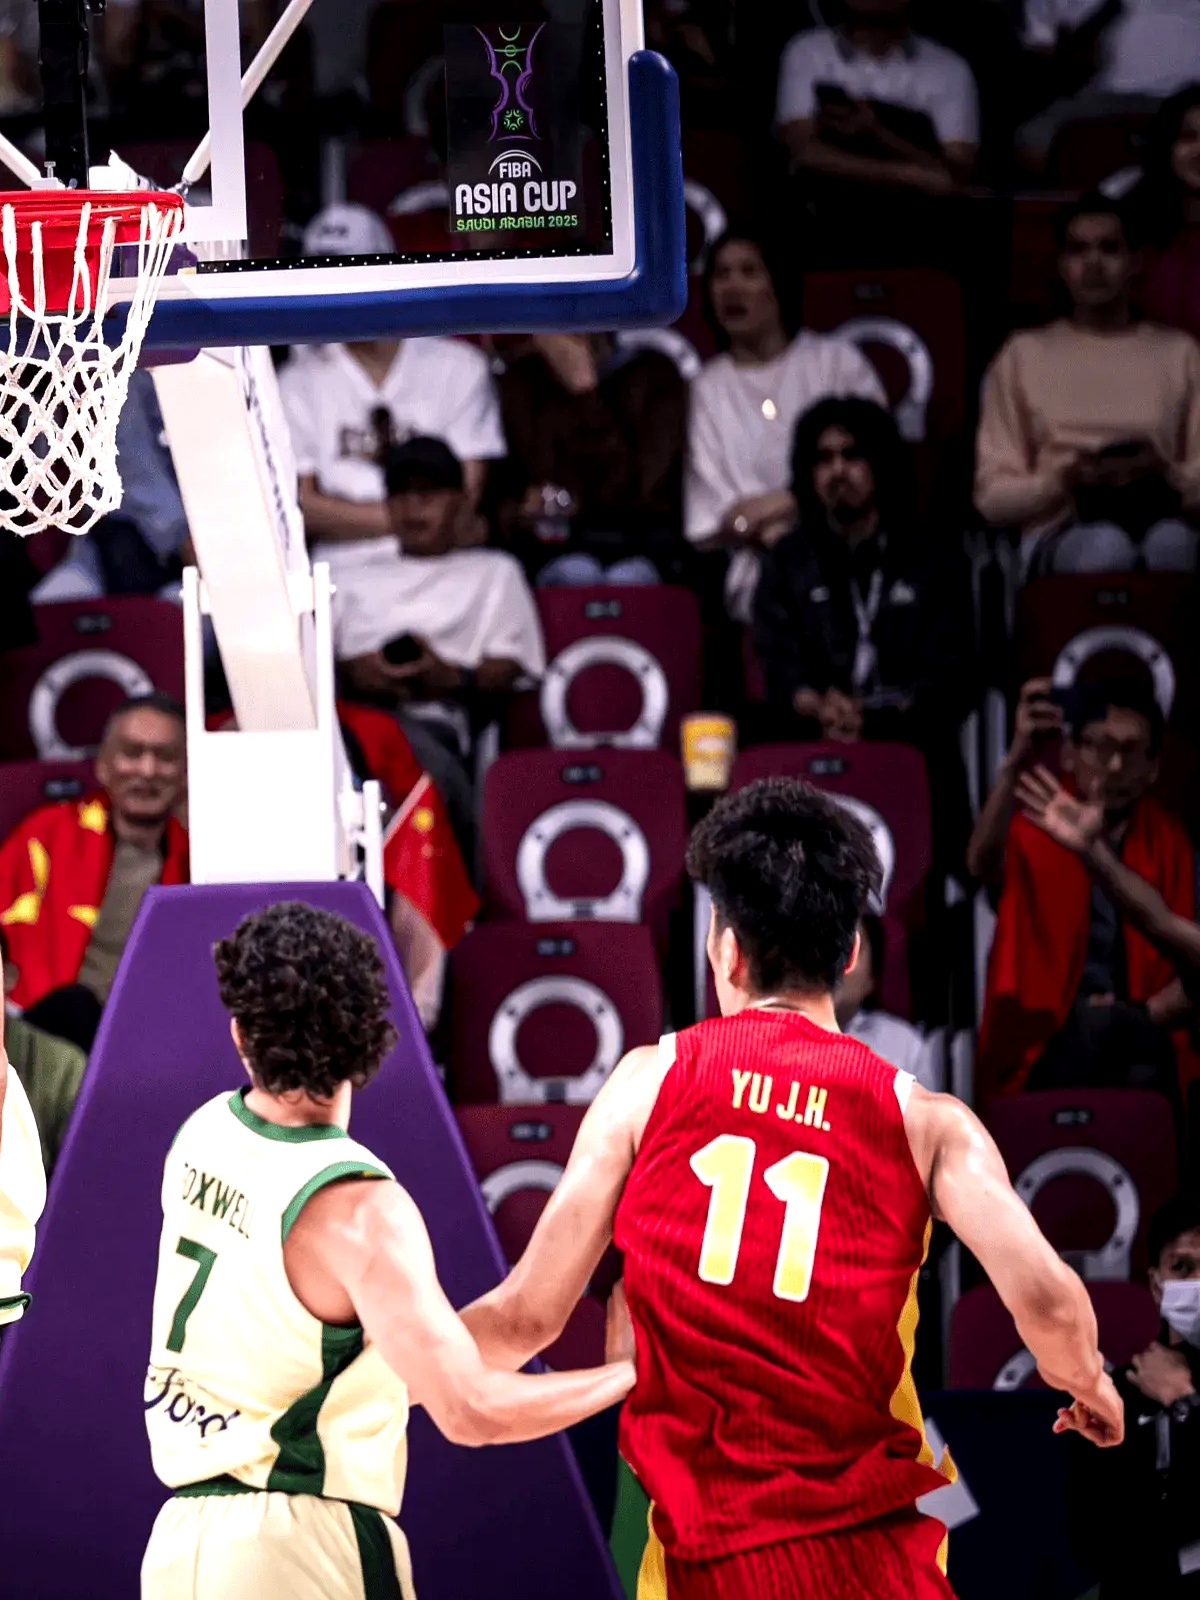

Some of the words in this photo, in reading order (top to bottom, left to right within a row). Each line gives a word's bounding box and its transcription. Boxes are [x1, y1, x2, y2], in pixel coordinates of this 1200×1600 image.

[455, 181, 517, 215] ASIA
[523, 180, 577, 212] CUP
[499, 161, 532, 179] FIBA
[456, 217, 496, 232] SAUDI
[498, 215, 545, 229] ARABIA
[548, 214, 578, 228] 2025
[731, 1068, 773, 1114] YU
[775, 1080, 832, 1132] J.H.
[181, 1162, 255, 1240] OXWEL
[689, 1133, 830, 1303] 11
[165, 1235, 219, 1354] 7
